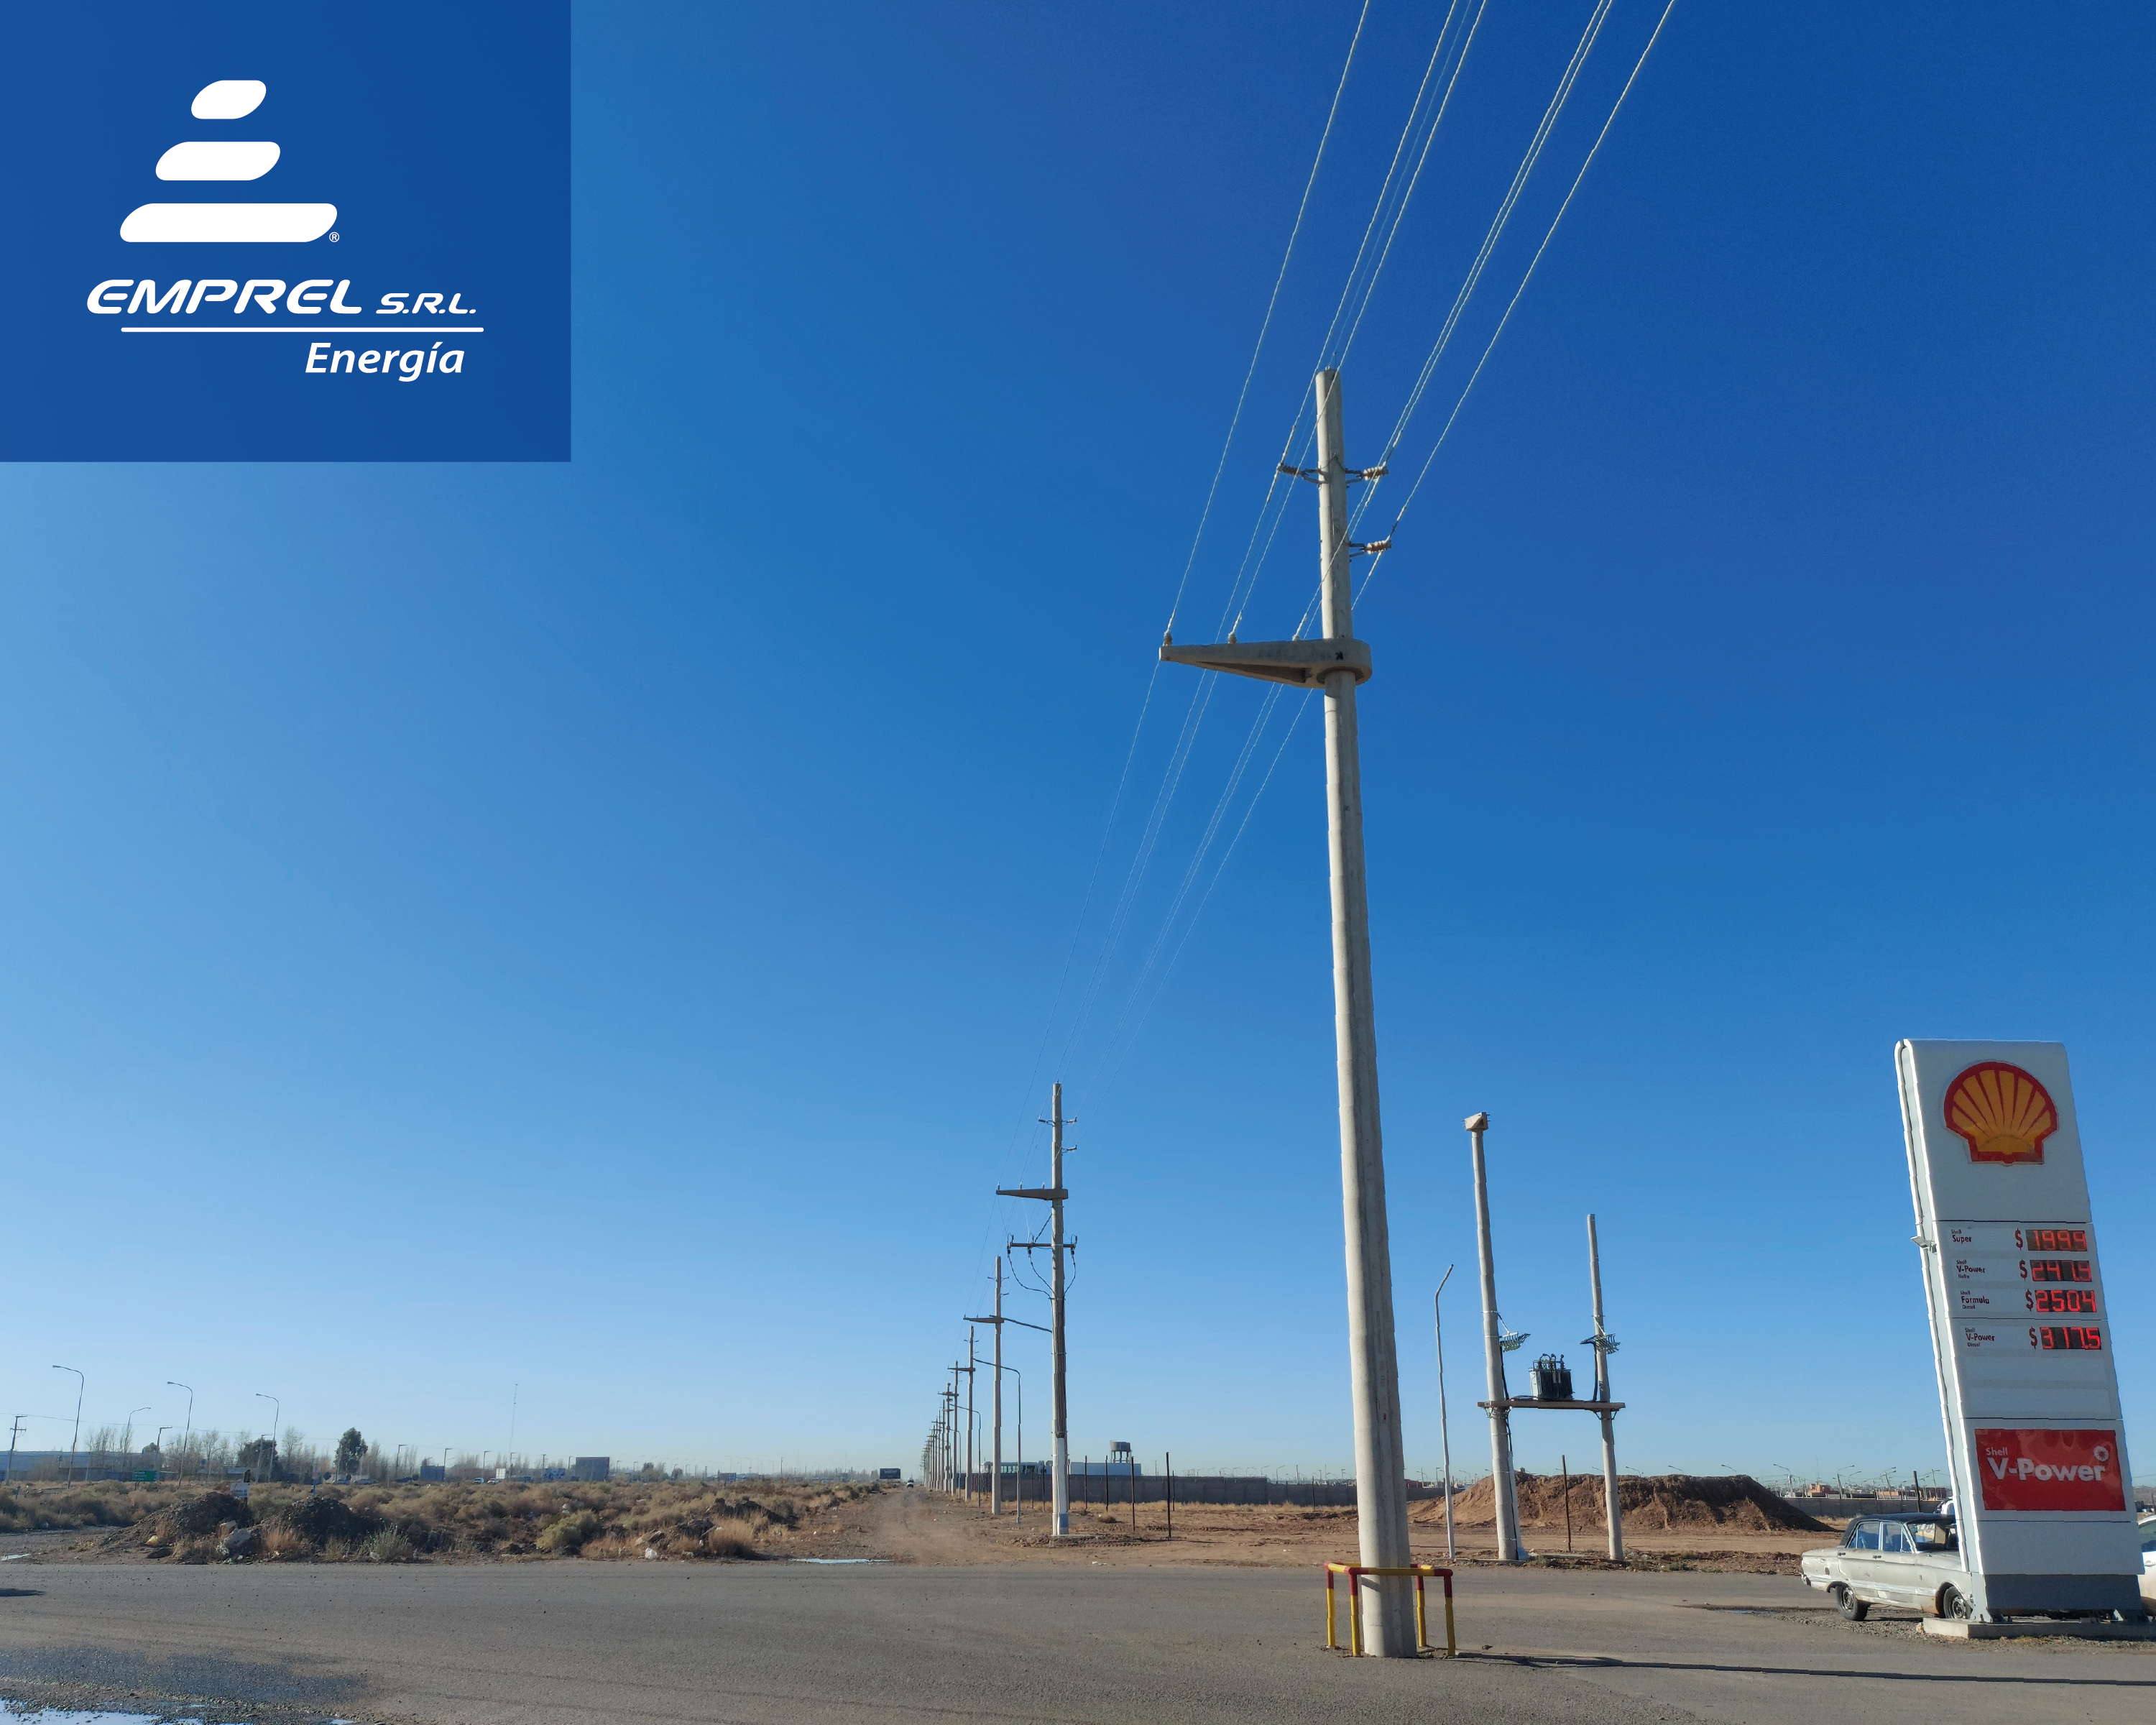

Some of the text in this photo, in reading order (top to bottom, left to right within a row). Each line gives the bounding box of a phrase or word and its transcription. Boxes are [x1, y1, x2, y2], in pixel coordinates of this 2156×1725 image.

[1952, 1235, 1972, 1244] Super
[1956, 1265, 1986, 1274] V-Power
[1961, 1295, 1990, 1305] Formula
[2035, 1289, 2097, 1312] 2504
[1966, 1333, 1995, 1342] V-Power
[1986, 1447, 2008, 1456] Shell
[1987, 1457, 2106, 1482] V-Power
